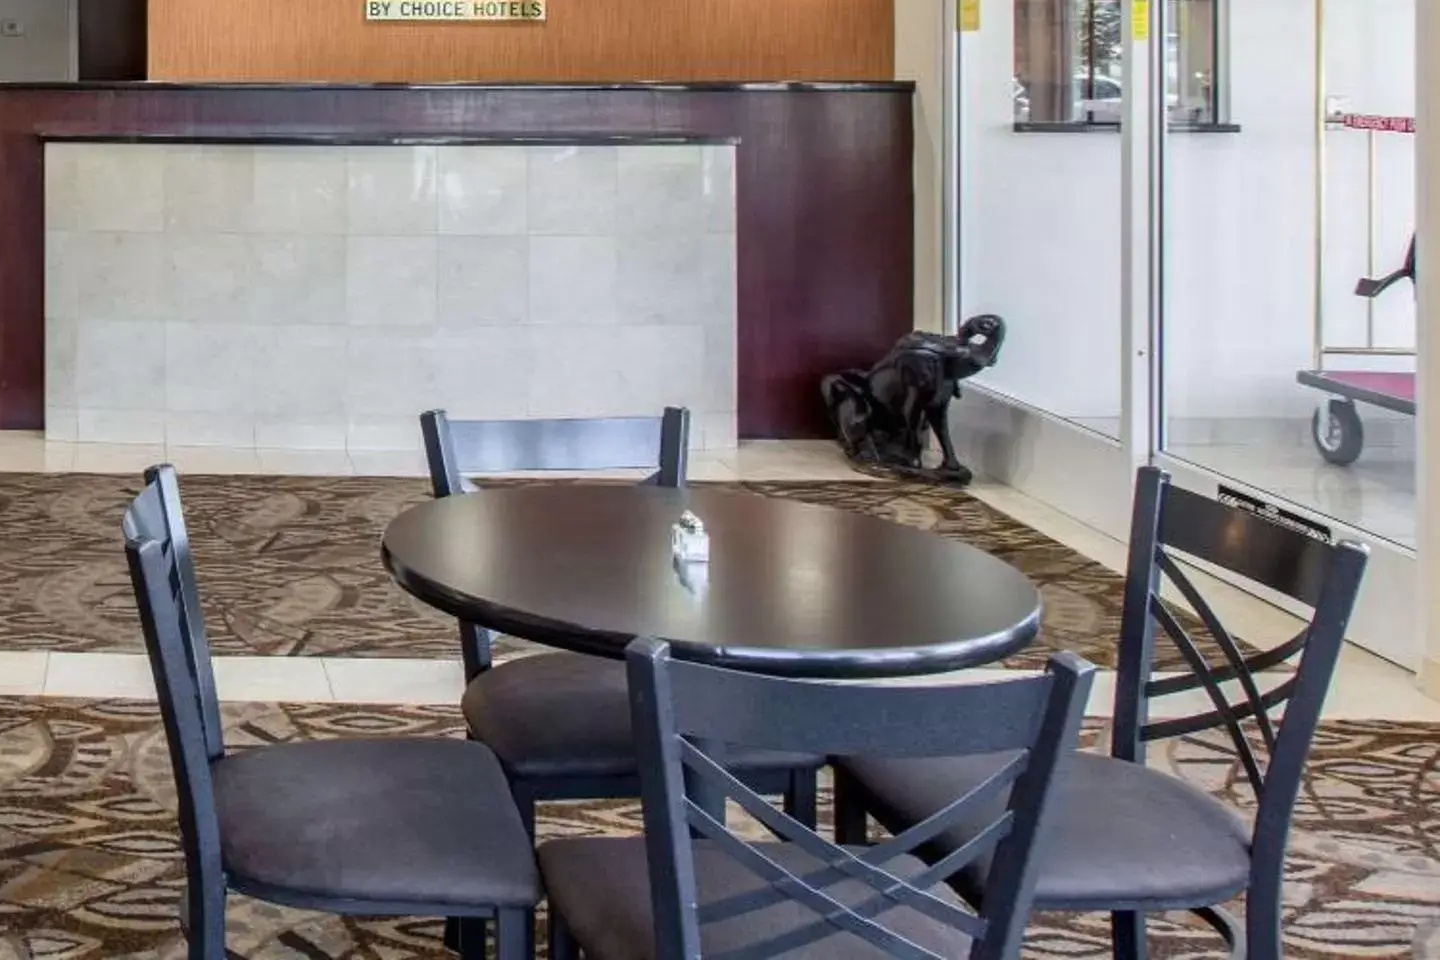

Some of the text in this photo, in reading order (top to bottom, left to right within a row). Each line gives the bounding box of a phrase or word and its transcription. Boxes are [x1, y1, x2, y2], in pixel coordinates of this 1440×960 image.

[369, 1, 543, 17] BY CHOICE HOTELS
